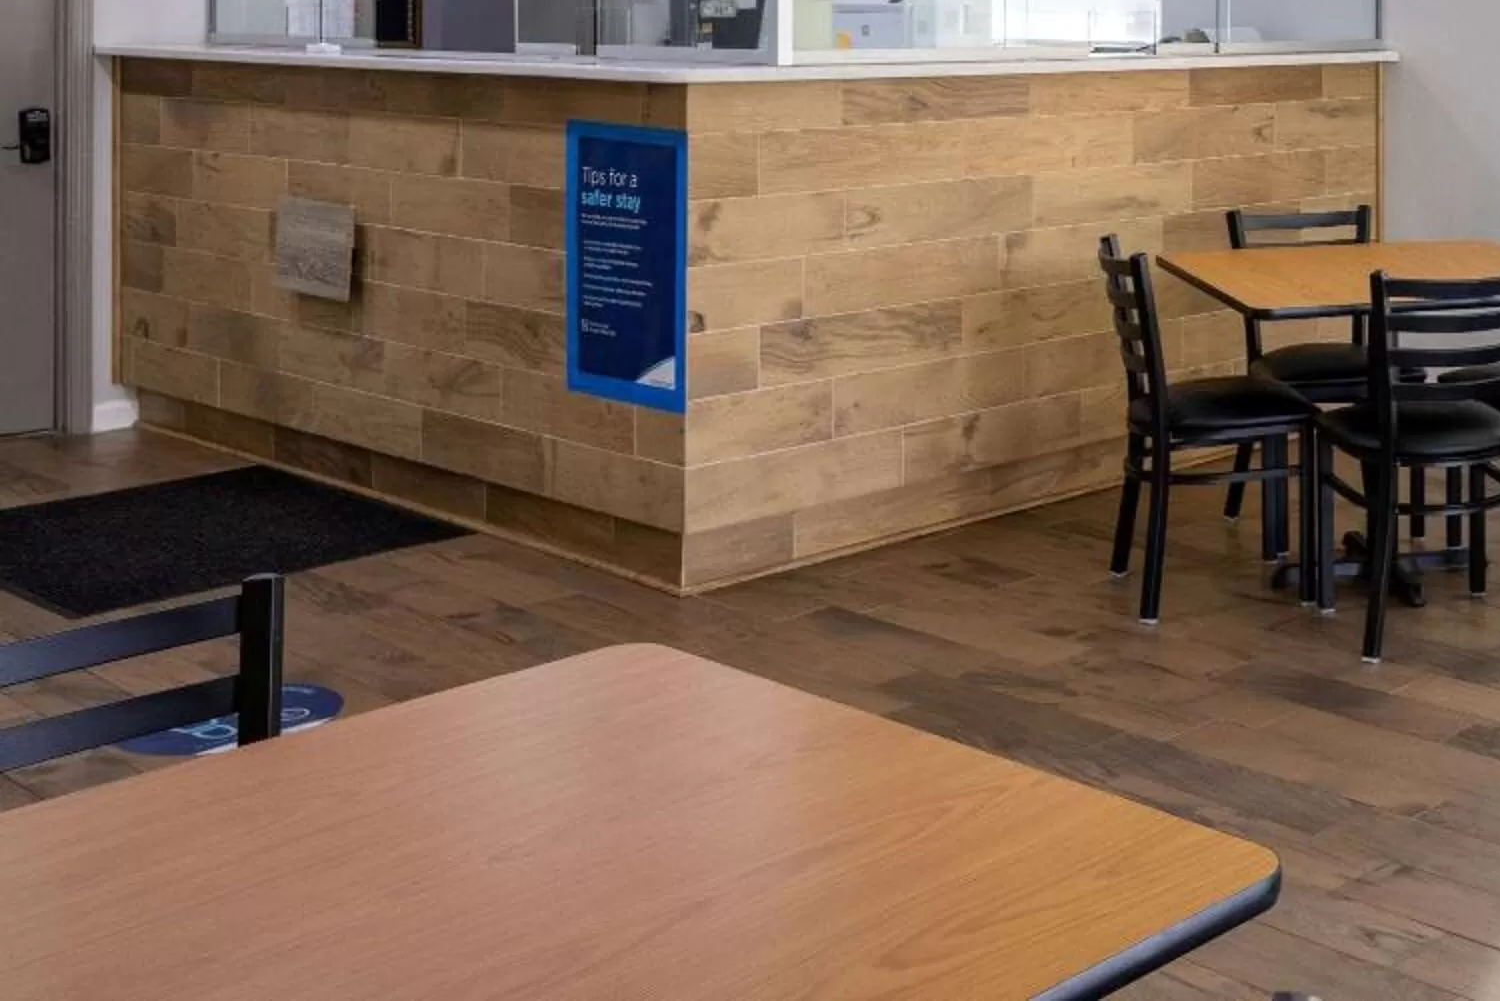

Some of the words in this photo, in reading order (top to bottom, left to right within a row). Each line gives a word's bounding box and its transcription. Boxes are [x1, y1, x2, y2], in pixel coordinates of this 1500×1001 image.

[582, 165, 607, 188] Tips
[608, 167, 627, 187] for
[629, 173, 639, 188] a
[581, 188, 613, 208] safer
[615, 192, 641, 214] stay
